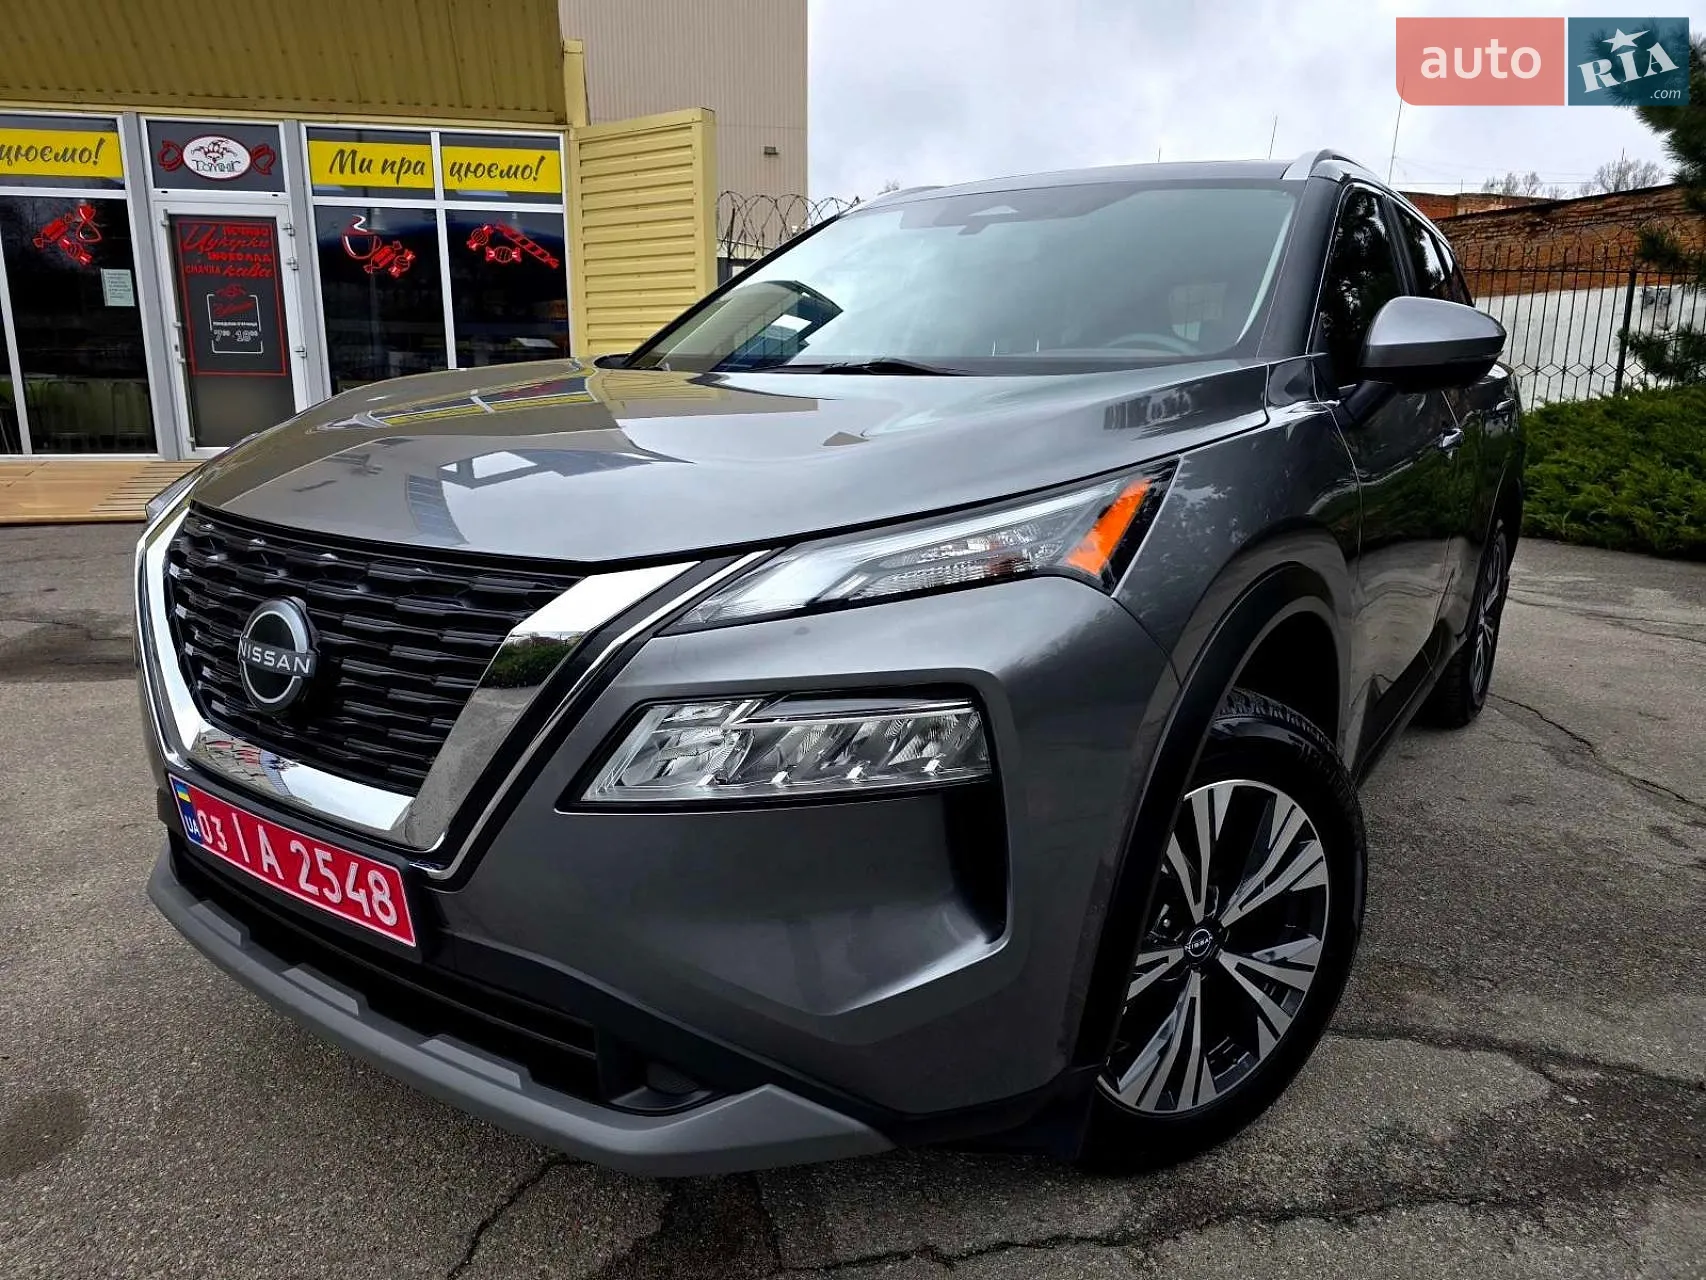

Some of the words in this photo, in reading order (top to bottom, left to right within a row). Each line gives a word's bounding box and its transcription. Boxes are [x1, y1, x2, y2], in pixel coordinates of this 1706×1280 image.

[329, 149, 373, 175] Ми
[380, 156, 425, 184] пра
[449, 156, 546, 183] цюємо!
[237, 636, 310, 674] NISSAN
[184, 816, 201, 837] UA
[289, 840, 398, 927] 2548
